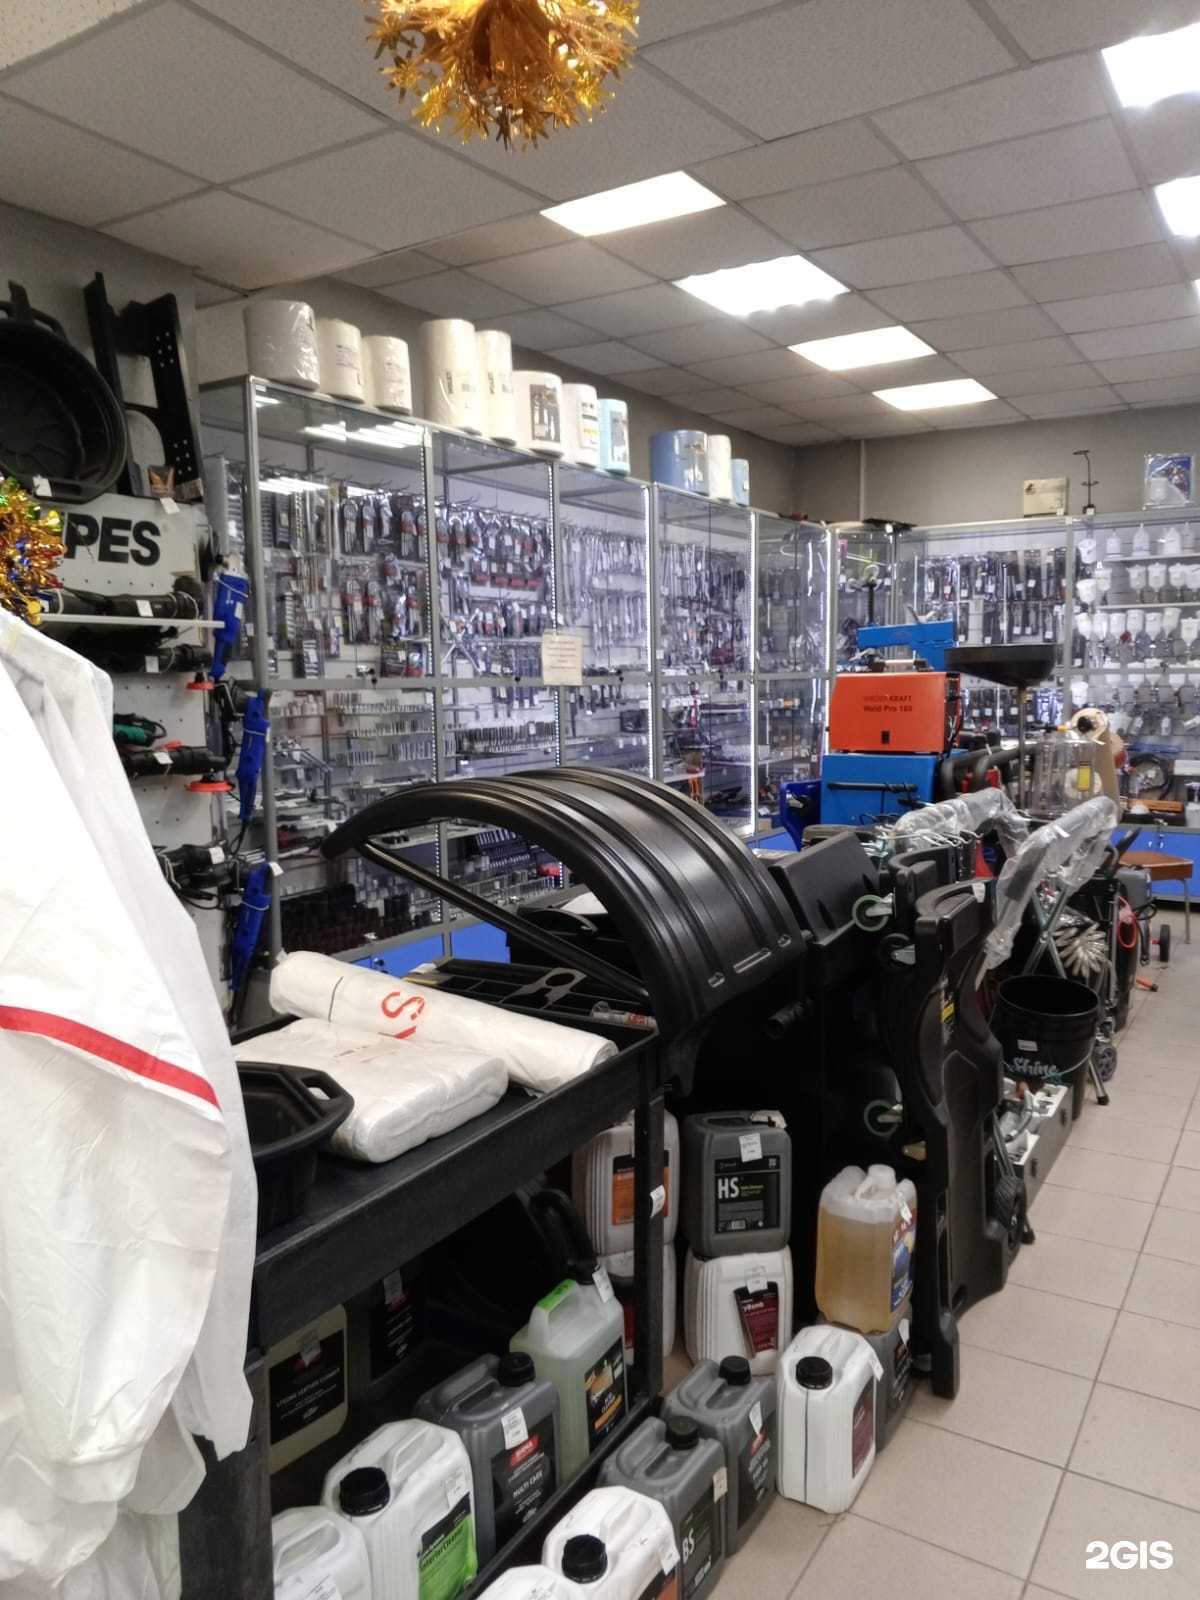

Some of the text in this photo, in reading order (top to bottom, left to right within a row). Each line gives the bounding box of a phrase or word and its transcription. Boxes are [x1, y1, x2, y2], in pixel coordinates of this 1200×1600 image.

[63, 512, 161, 567] PES
[717, 1176, 741, 1200] HS
[681, 1527, 696, 1565] BS
